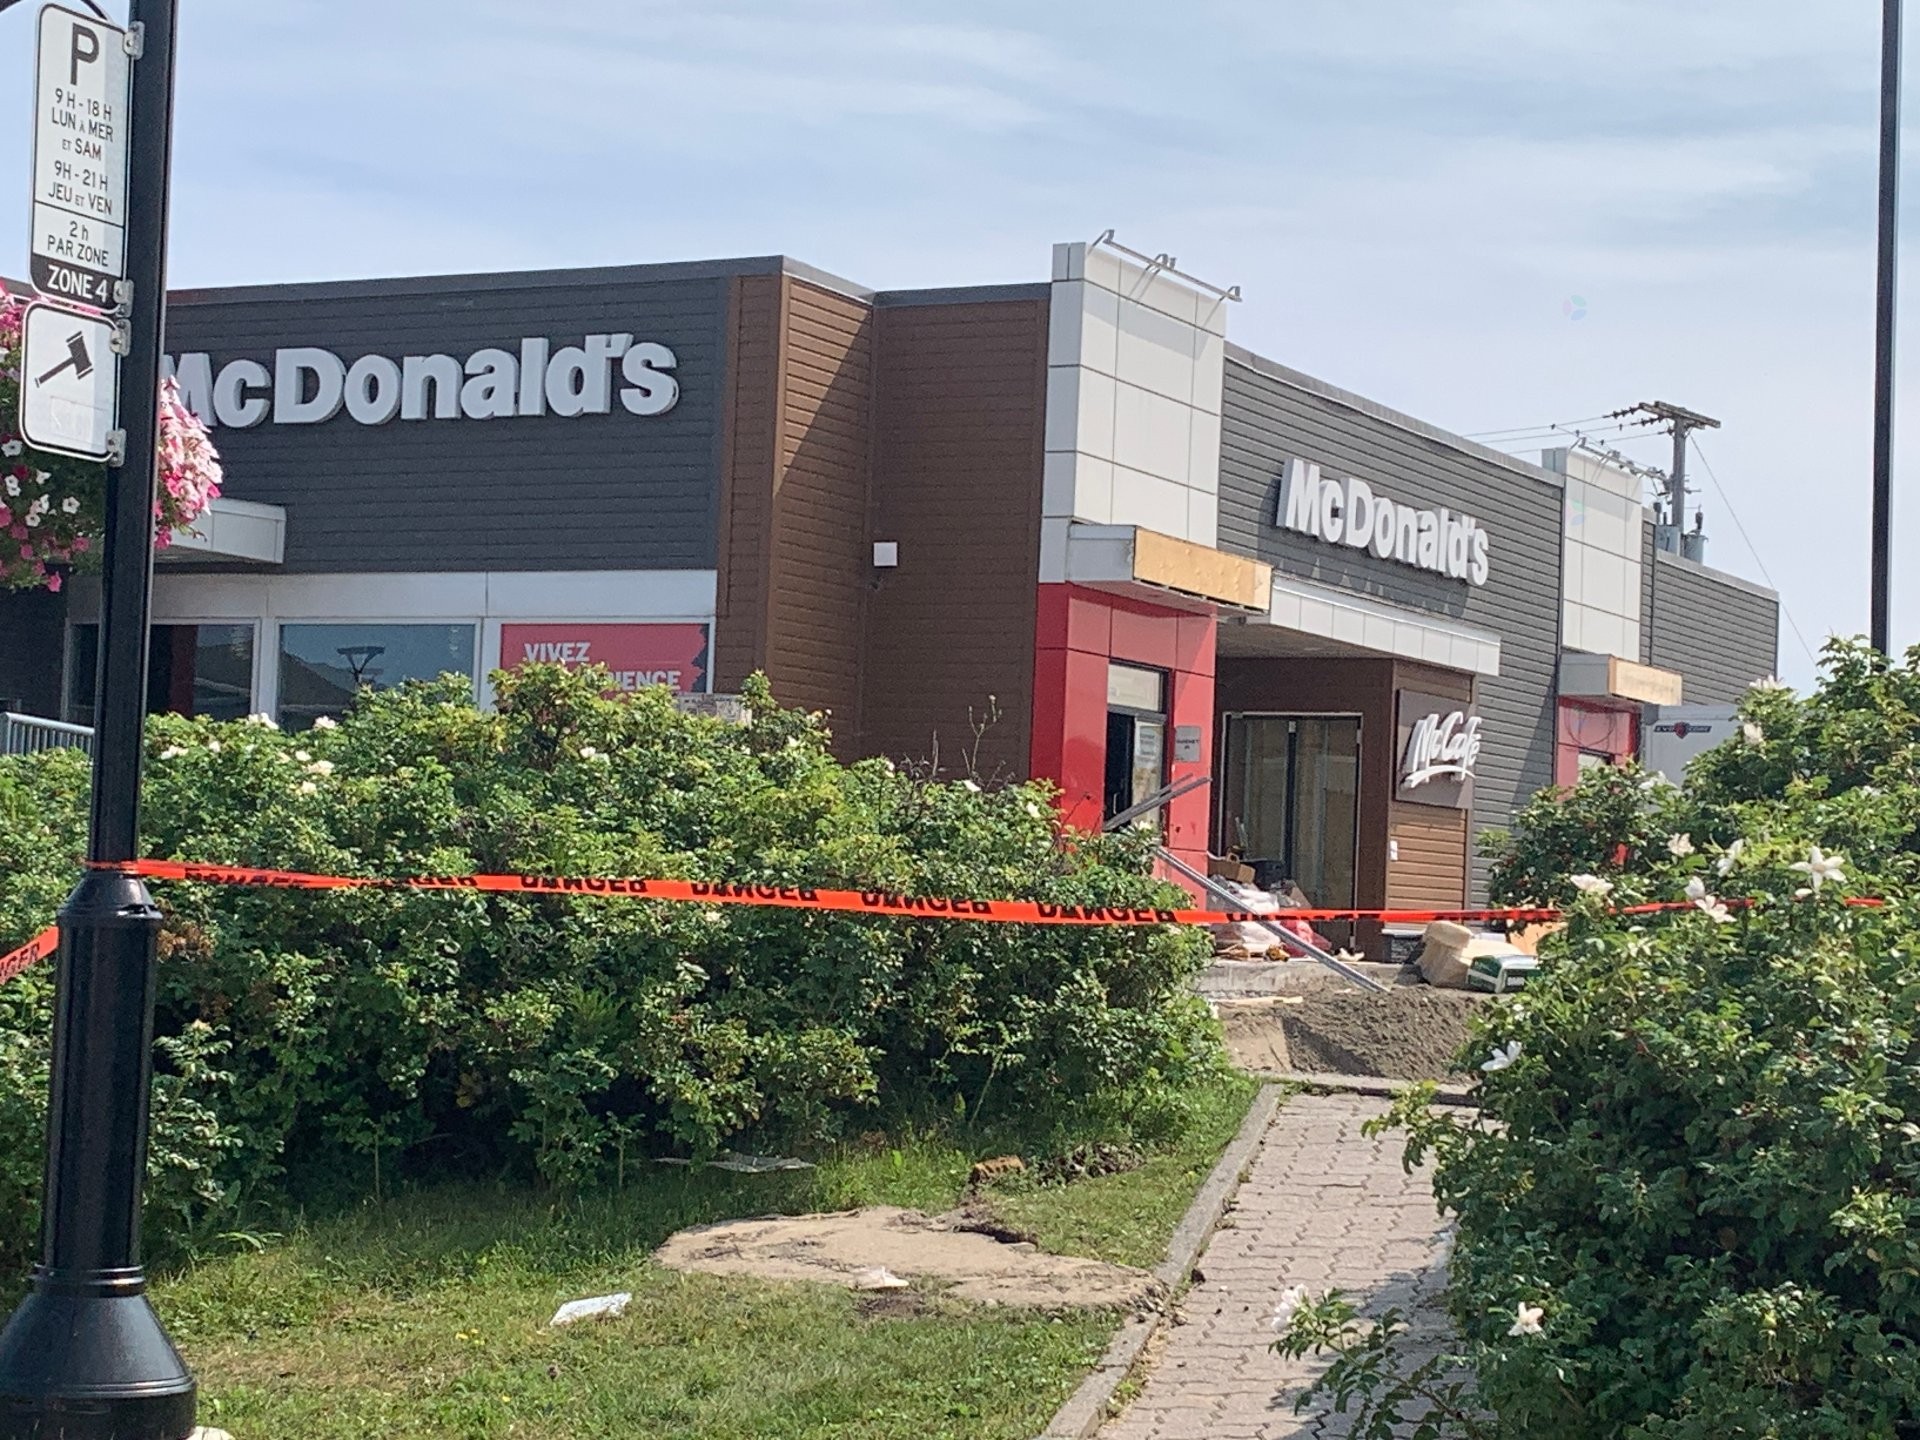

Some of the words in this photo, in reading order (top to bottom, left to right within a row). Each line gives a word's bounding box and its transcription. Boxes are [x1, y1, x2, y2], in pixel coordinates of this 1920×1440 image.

[70, 22, 99, 86] P
[52, 106, 76, 130] LUN
[88, 119, 114, 142] MER
[62, 139, 72, 151] ET
[74, 138, 102, 161] SAM
[48, 181, 73, 203] JEU
[75, 194, 85, 207] ET
[88, 192, 112, 216] VEN
[47, 234, 74, 258] PAR
[77, 243, 109, 267] ZONE
[47, 263, 94, 300] ZONE
[95, 279, 108, 303] 4
[160, 332, 679, 429] McDonald's
[1276, 458, 1489, 586] McDonald's
[524, 642, 591, 662] VIVEZ
